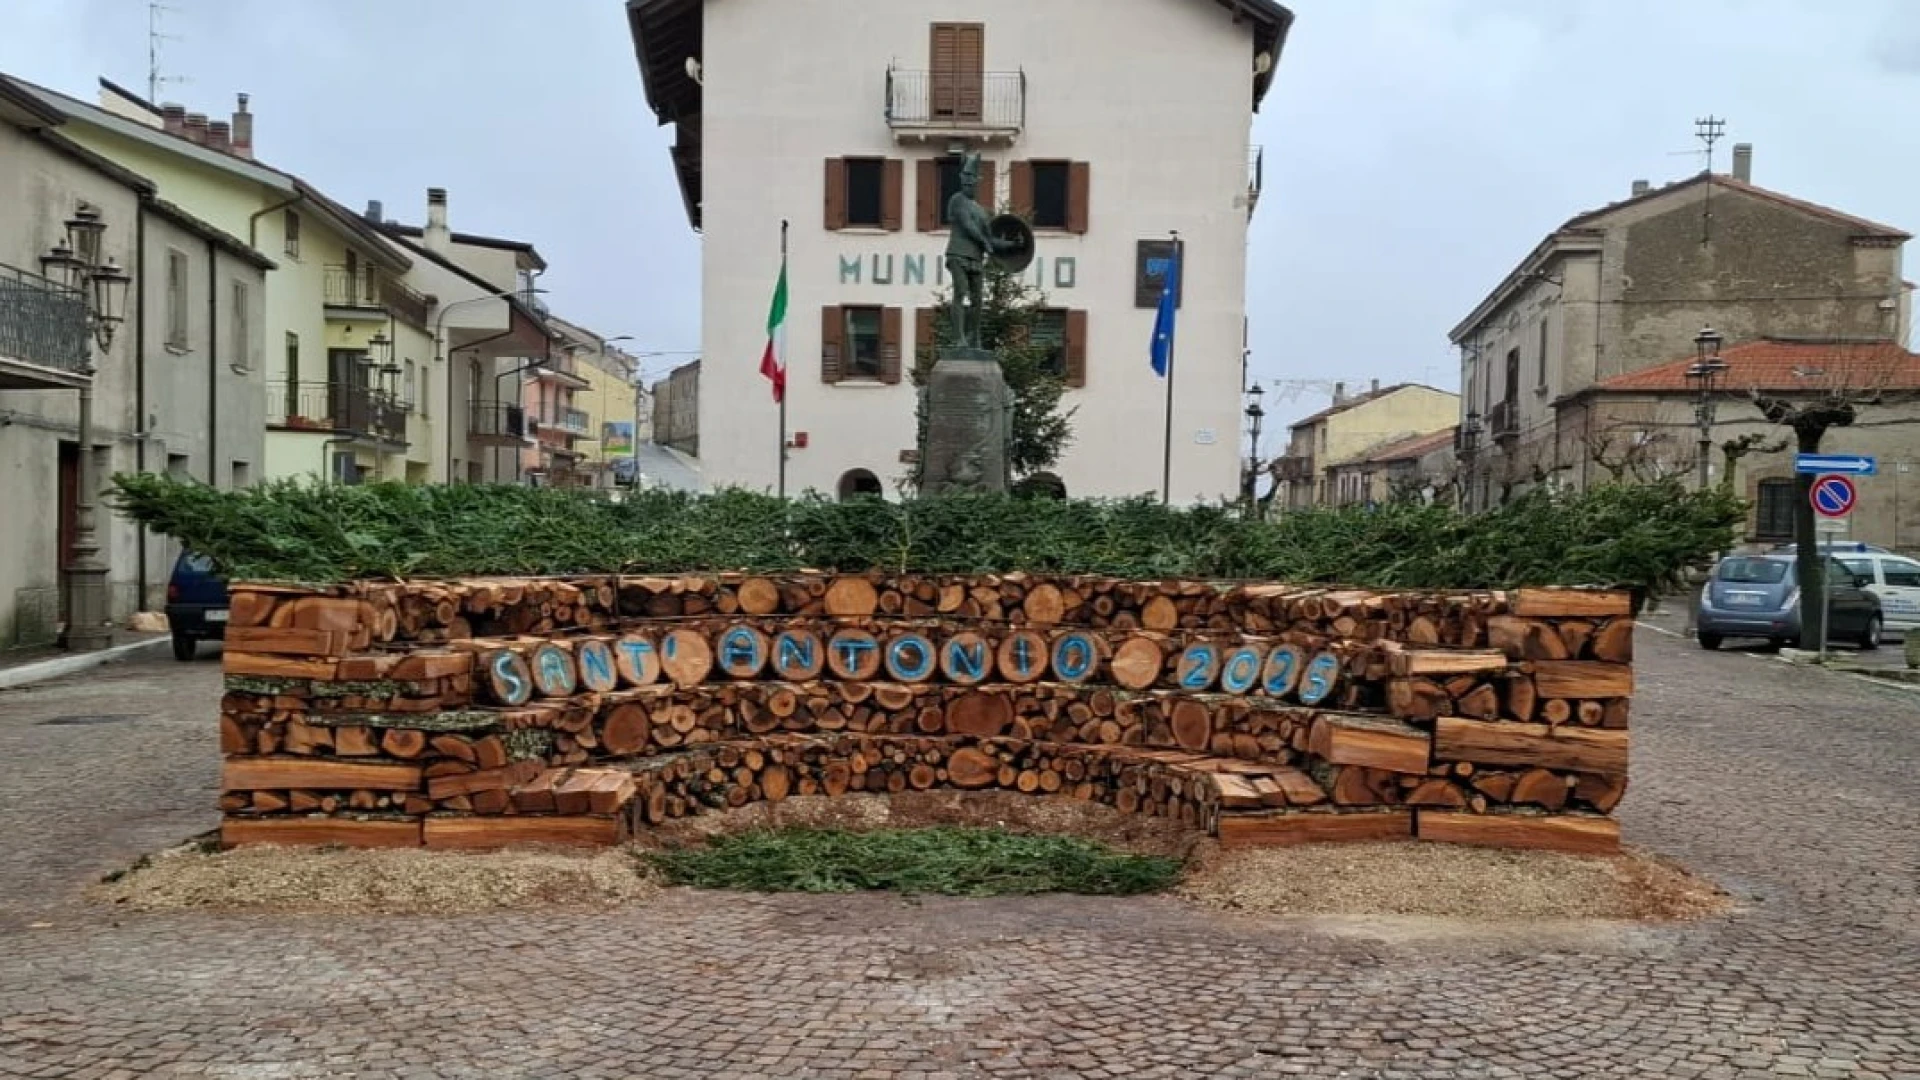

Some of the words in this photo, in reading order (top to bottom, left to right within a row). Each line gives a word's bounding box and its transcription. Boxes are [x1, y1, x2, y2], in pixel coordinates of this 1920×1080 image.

[839, 253, 1076, 288] MUNIIO
[492, 636, 677, 703] SANT'
[717, 627, 1095, 682] ANTONIO
[1178, 643, 1338, 702] 2025
